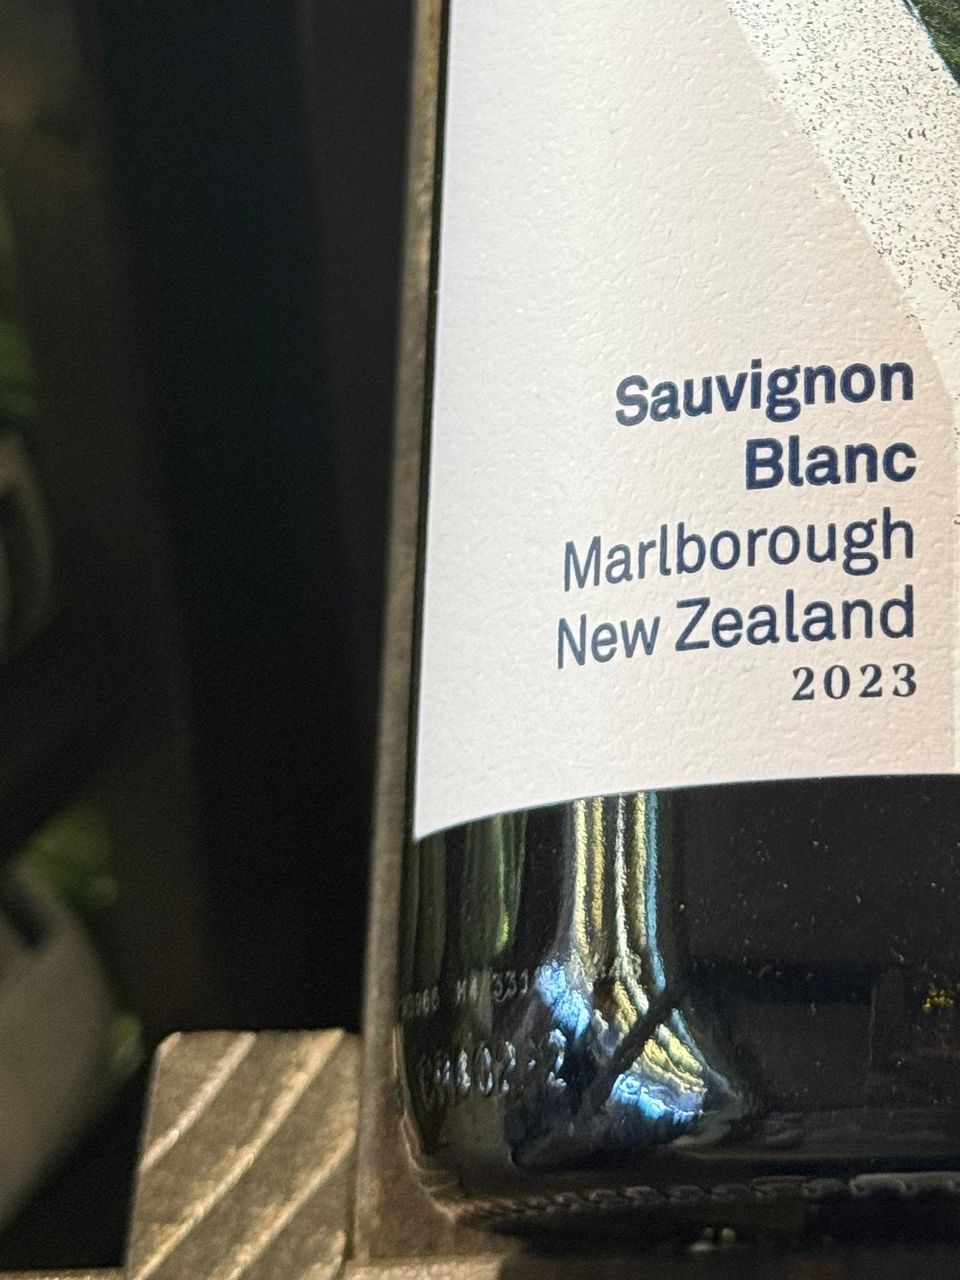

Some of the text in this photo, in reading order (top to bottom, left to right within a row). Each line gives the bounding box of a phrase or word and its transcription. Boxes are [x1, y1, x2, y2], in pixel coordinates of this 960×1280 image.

[615, 358, 914, 427] Sauvignon
[745, 434, 917, 490] Blanc
[563, 506, 914, 593] Marlborough
[556, 583, 914, 670] New Zealand
[790, 662, 918, 701] 2023
